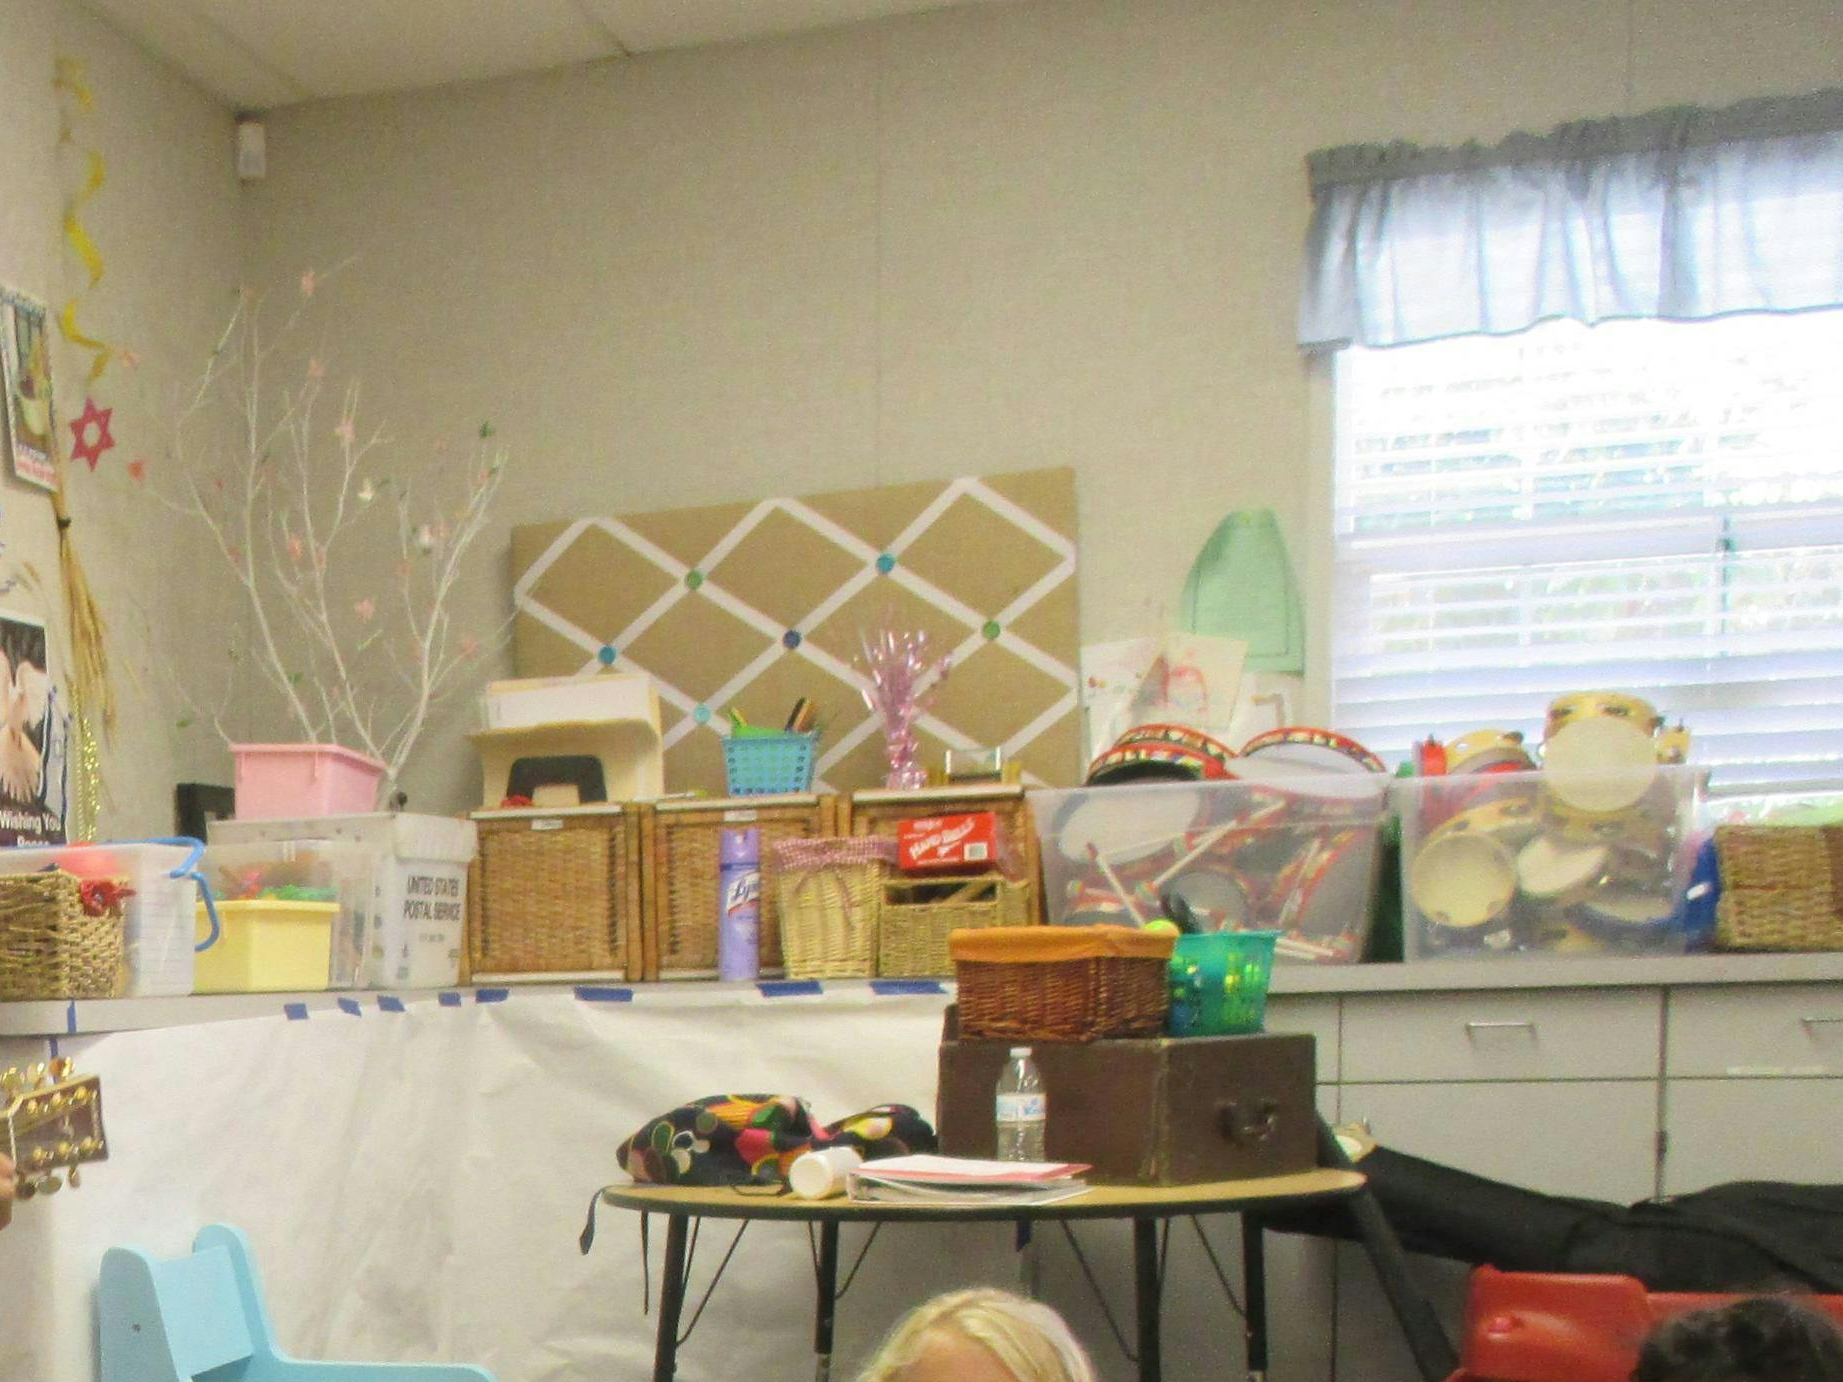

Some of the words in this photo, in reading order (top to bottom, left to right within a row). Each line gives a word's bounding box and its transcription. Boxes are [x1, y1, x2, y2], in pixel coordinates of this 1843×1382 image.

[0, 810, 42, 835] Wishing
[406, 874, 434, 895] UNITED
[435, 877, 460, 897] STATES
[403, 899, 433, 919] POSTAL
